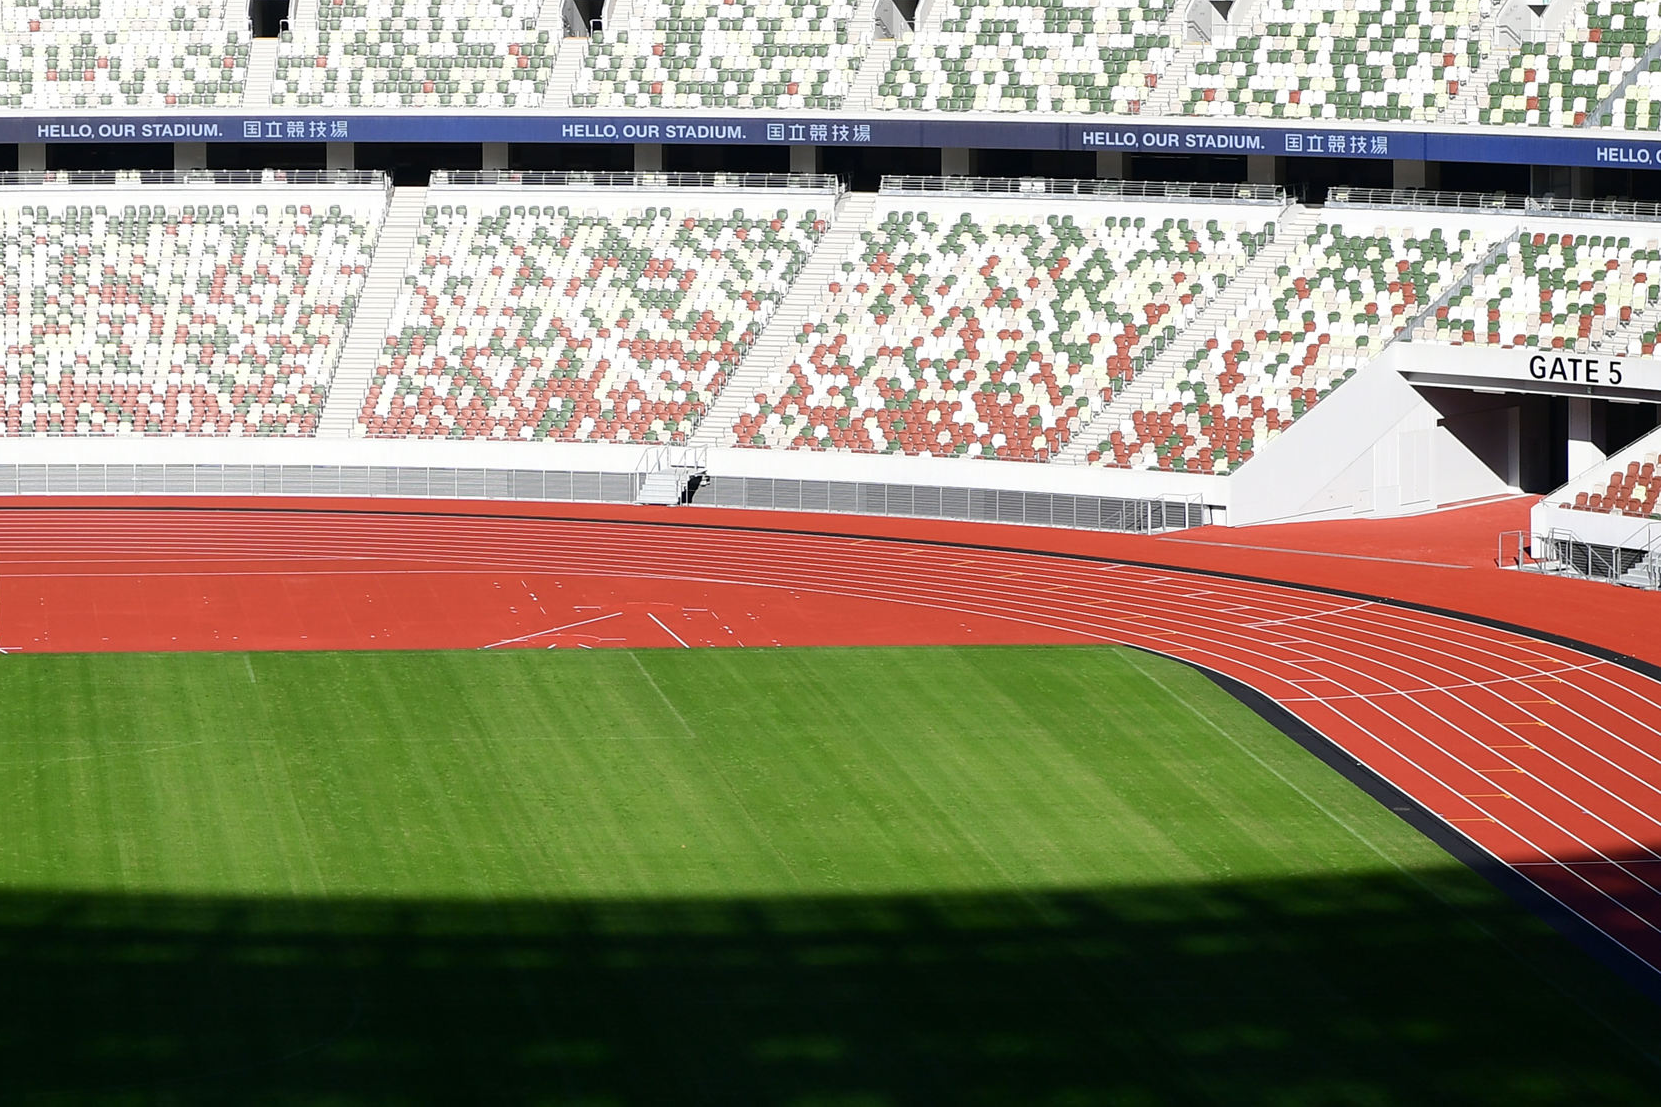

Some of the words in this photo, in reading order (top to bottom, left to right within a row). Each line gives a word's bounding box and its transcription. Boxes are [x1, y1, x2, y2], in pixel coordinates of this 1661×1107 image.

[38, 125, 95, 139] HELLO,
[99, 124, 135, 138] OUR
[142, 124, 222, 137] STADIUM.
[244, 121, 348, 138] 国立競技場
[562, 124, 619, 139] HELLO,
[623, 125, 659, 139] OUR
[666, 125, 746, 139] STADIUM.
[767, 124, 870, 142] 国立競技場
[1083, 132, 1138, 147] HELLO,
[1143, 133, 1179, 148] OUR
[1186, 135, 1265, 150] STADIUM.
[1286, 134, 1387, 154] 国立競技場
[1596, 146, 1653, 165] HELLO,
[1529, 355, 1599, 383] GATE
[1609, 361, 1622, 385] 5
